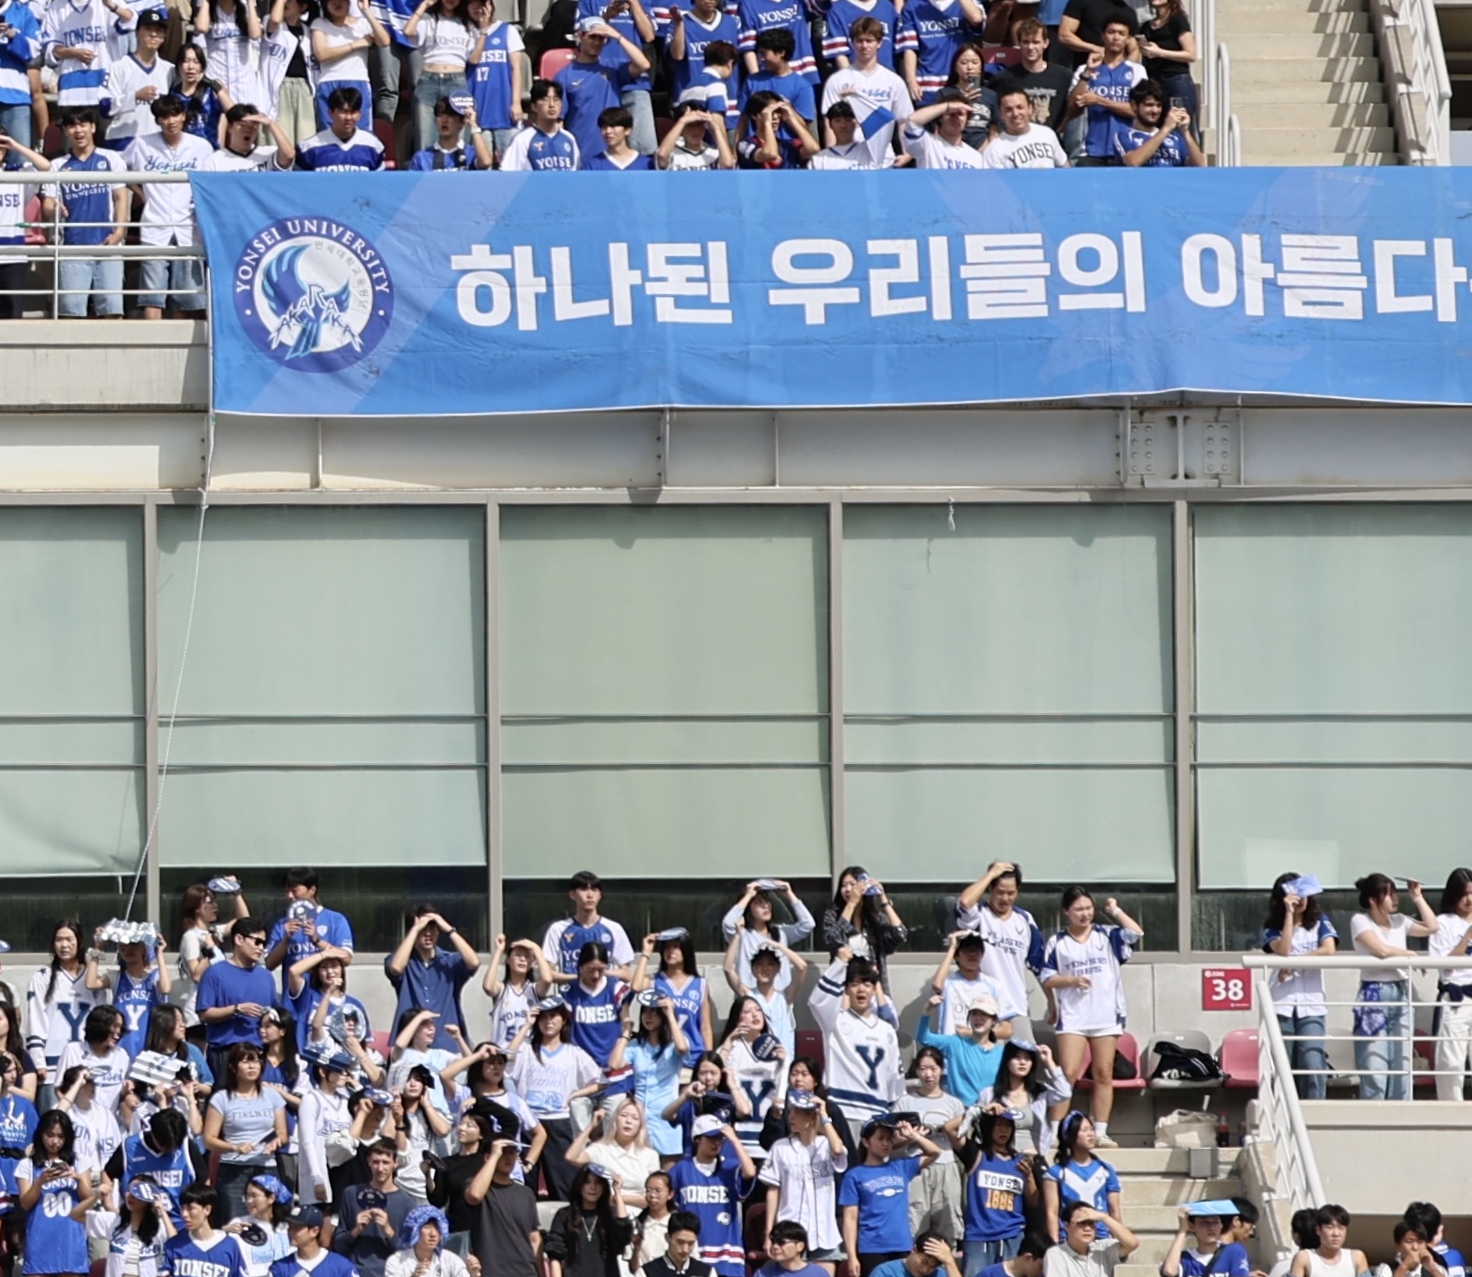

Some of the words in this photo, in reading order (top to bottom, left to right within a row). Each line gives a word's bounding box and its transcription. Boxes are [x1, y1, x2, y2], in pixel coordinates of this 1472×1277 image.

[477, 67, 489, 81] 17
[237, 227, 282, 292] YONSEI
[287, 220, 389, 293] UNIVERSITY
[452, 238, 734, 332] 하나된
[768, 229, 1145, 328] 우리들의
[1211, 978, 1244, 1002] 38
[58, 1003, 88, 1040] Y
[856, 1046, 884, 1090] Y
[43, 1193, 72, 1218] 00
